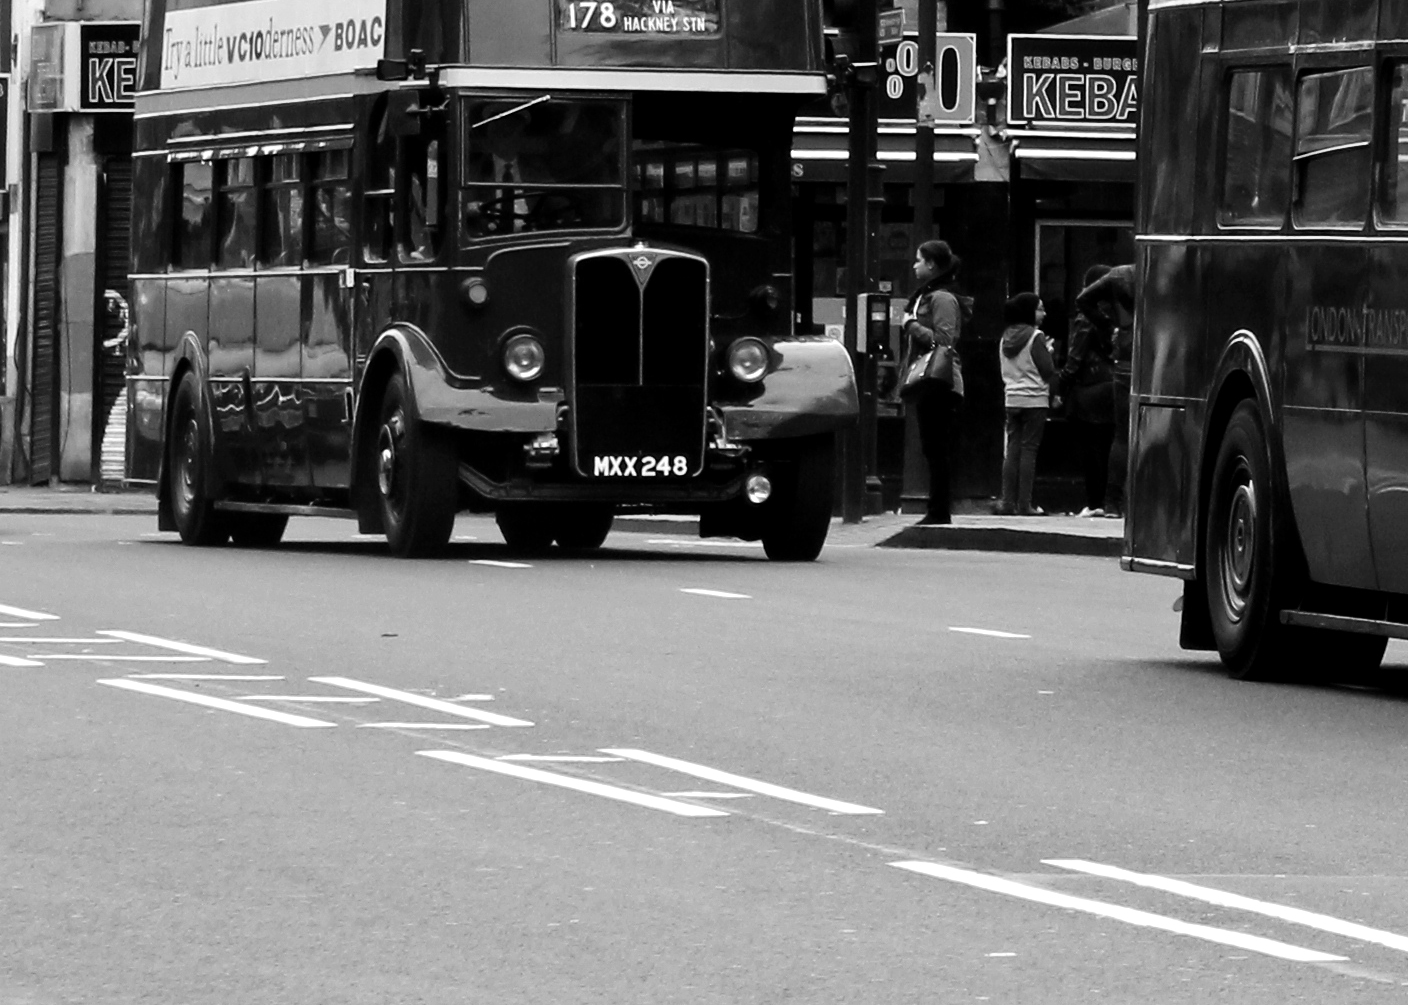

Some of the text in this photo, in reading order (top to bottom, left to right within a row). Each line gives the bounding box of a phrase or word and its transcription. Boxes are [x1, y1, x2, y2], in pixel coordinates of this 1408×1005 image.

[569, 1, 617, 29] 178
[652, 0, 675, 14] VIA
[623, 16, 706, 32] HACKNEY STN
[164, 27, 182, 81] Try
[184, 41, 191, 68] a
[194, 23, 224, 68] little
[334, 15, 383, 52] BOAC
[1023, 56, 1080, 70] KEBABS
[88, 57, 137, 103] KE
[1023, 73, 1138, 120] KEBA
[593, 455, 688, 477] MXX 248
